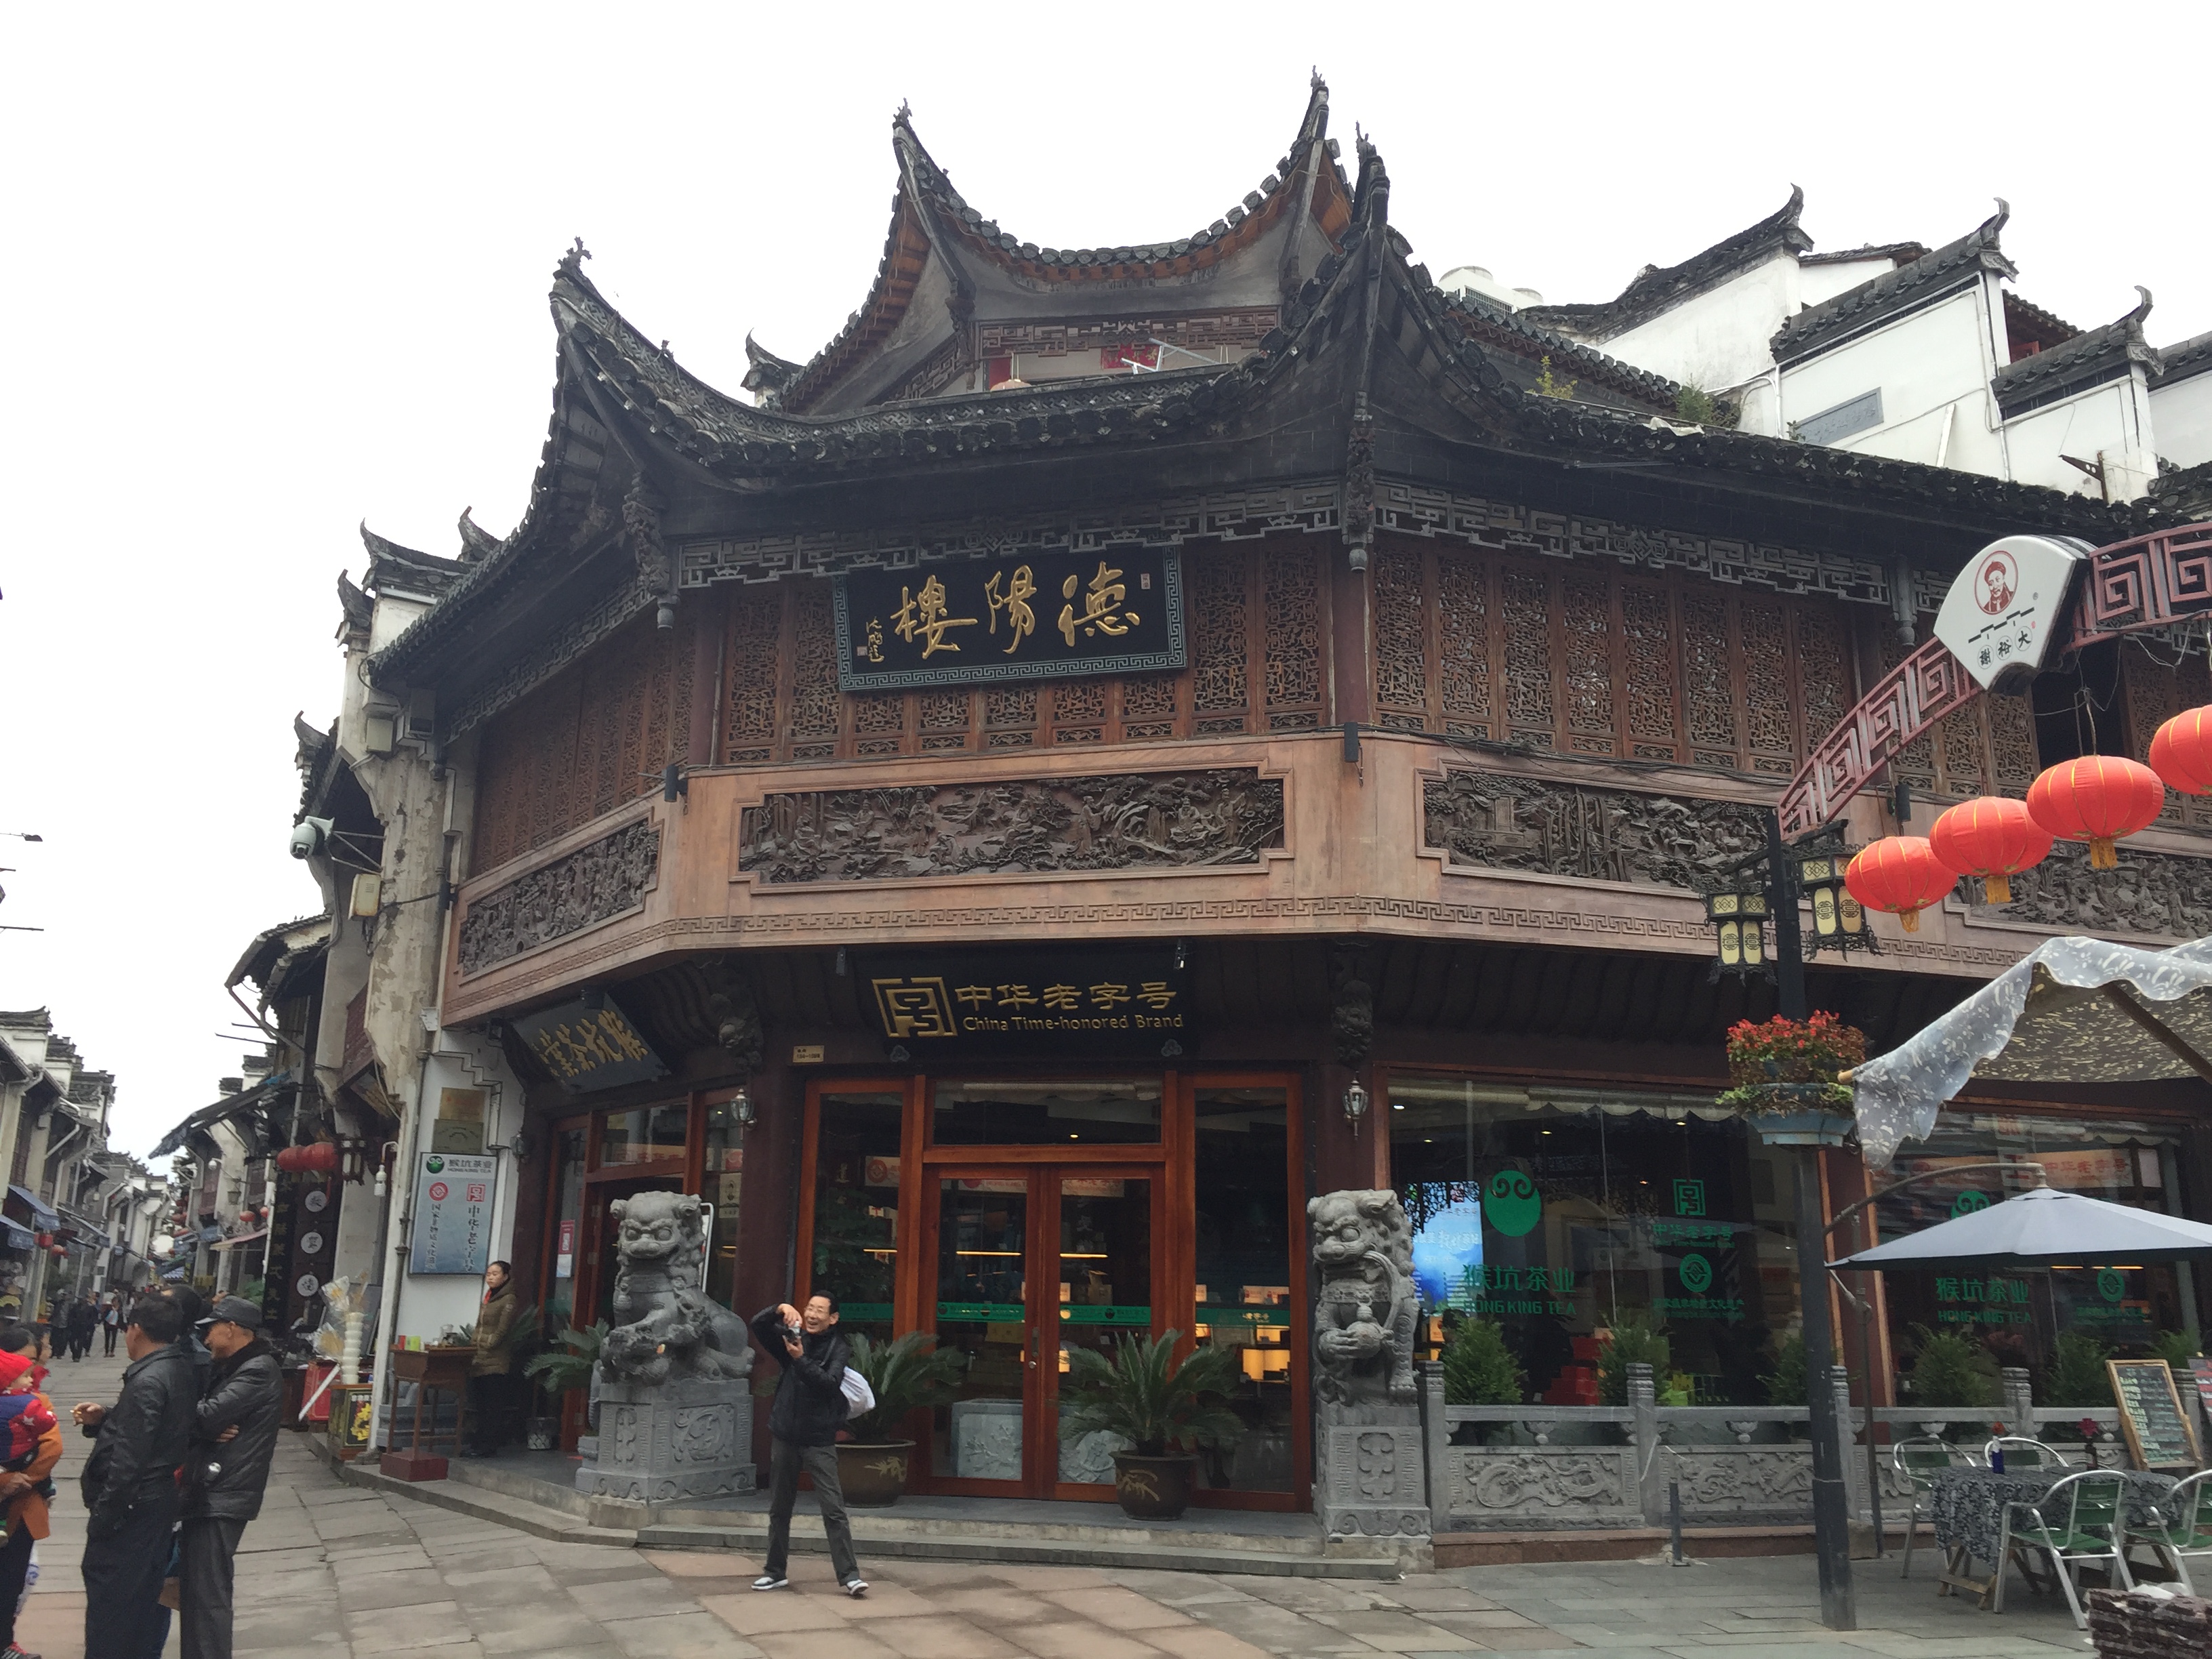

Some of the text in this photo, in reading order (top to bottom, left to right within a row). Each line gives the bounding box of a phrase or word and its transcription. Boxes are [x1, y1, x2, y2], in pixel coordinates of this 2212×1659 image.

[955, 981, 1178, 1012] 中华老字号
[962, 1014, 1183, 1031] China Time-honored Brand
[1462, 1264, 1576, 1292] 猴坑茶业
[1936, 1277, 2030, 1303] 猴坑茶业
[1546, 1300, 1577, 1315] TEA
